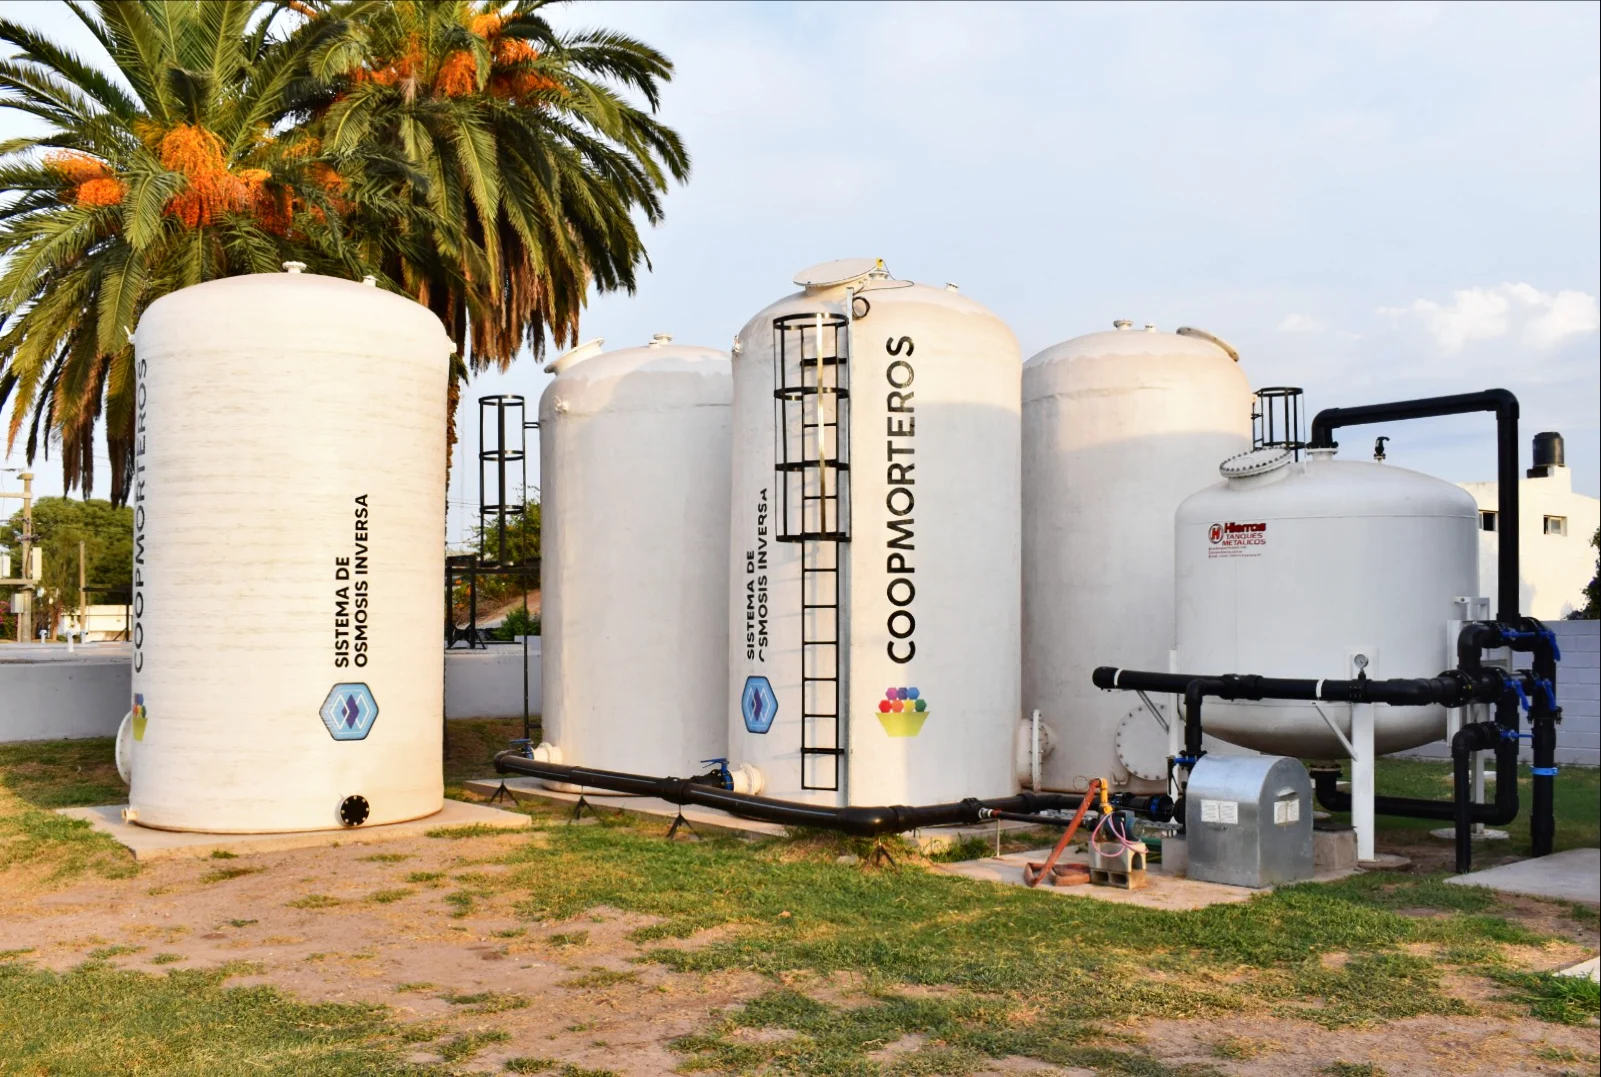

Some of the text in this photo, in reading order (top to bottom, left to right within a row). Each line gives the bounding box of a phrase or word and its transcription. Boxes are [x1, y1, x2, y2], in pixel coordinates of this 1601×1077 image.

[134, 357, 147, 673] COOPMORTEROS
[758, 488, 768, 569] INVERSA
[886, 335, 916, 664] COOPMORTEROS
[335, 557, 350, 668] SISTEMA DE
[354, 494, 369, 668] OSMOSIS INVERSA
[746, 550, 755, 661] SISTEMA DE
